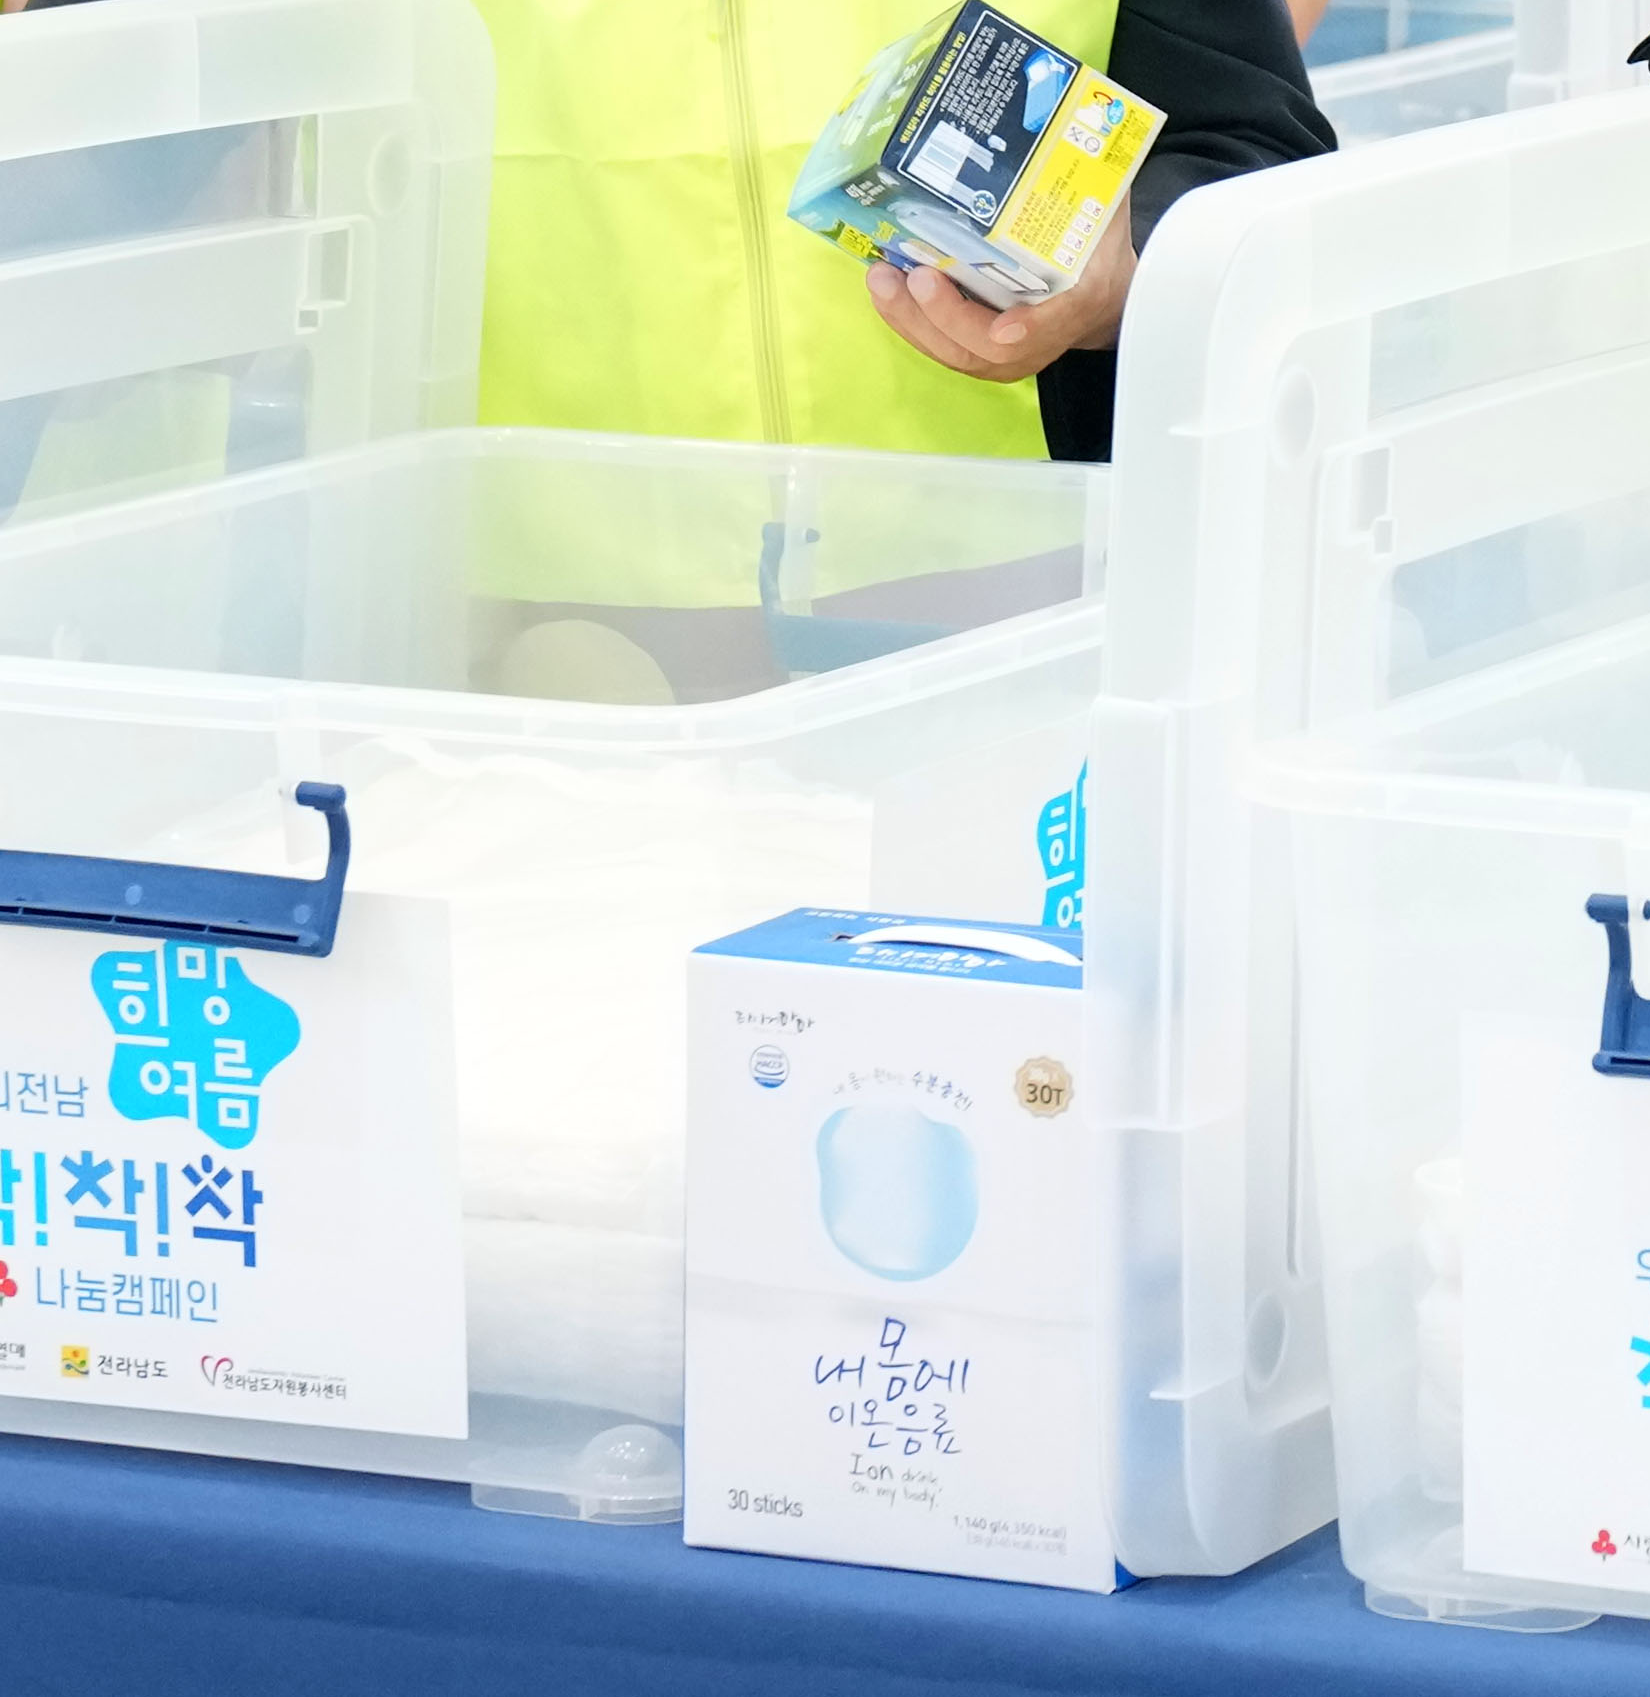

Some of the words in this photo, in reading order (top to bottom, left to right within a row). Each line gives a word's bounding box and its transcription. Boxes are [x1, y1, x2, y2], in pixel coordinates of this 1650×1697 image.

[112, 946, 236, 1047] 희망
[139, 1037, 261, 1130] 여름
[36, 1266, 218, 1323] 나눔캠페인
[97, 1354, 169, 1378] 전라남도
[815, 1355, 866, 1388] 내
[829, 1399, 962, 1456] 이온음료
[850, 1454, 894, 1482] Ion
[728, 1488, 749, 1512] 30
[752, 1491, 804, 1519] sticks
[877, 1486, 897, 1508] my
